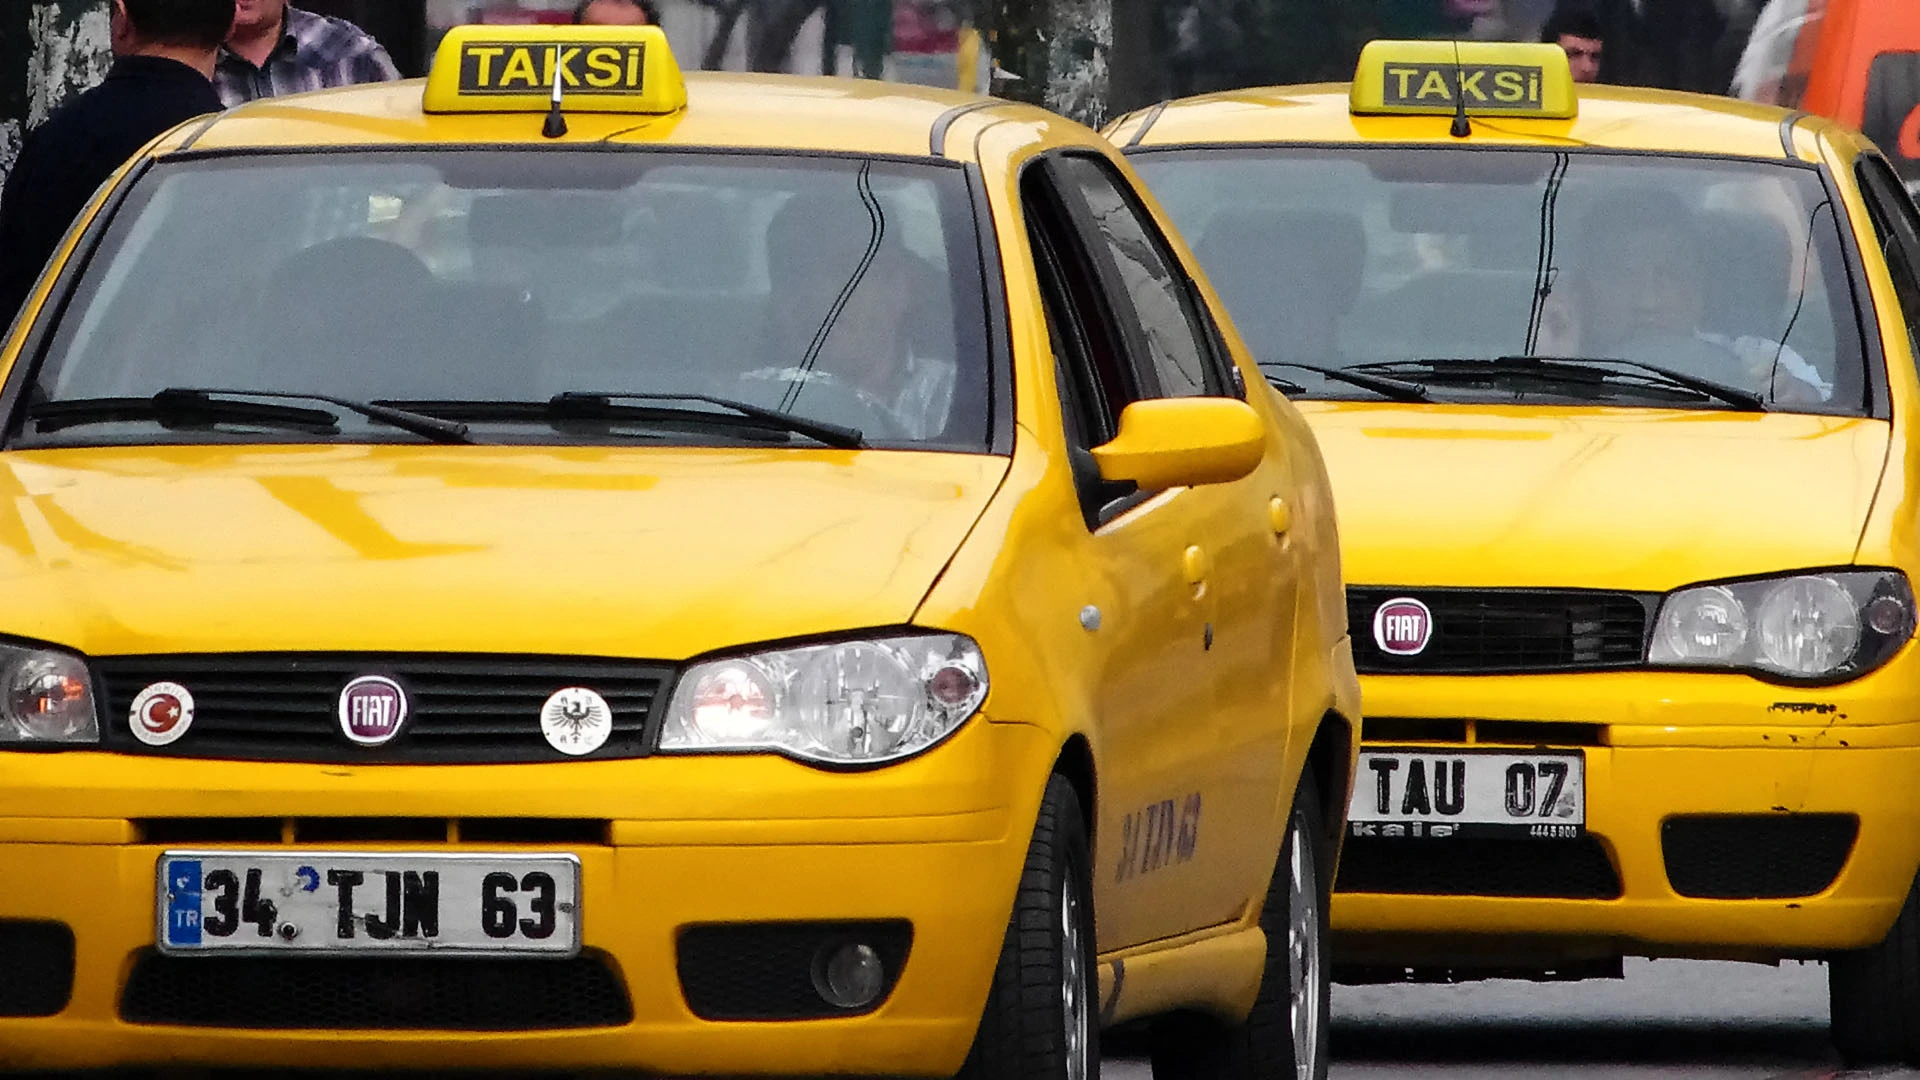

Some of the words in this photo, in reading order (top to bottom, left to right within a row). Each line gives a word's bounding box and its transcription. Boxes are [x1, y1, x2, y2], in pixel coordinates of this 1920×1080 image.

[1386, 614, 1421, 642] FIAT
[352, 695, 393, 727] FIAT
[1369, 757, 1465, 816] TAU
[1505, 759, 1569, 817] 07
[175, 910, 199, 928] TR
[203, 868, 278, 938] 34
[328, 869, 440, 940] TJN
[482, 871, 556, 940] 63
